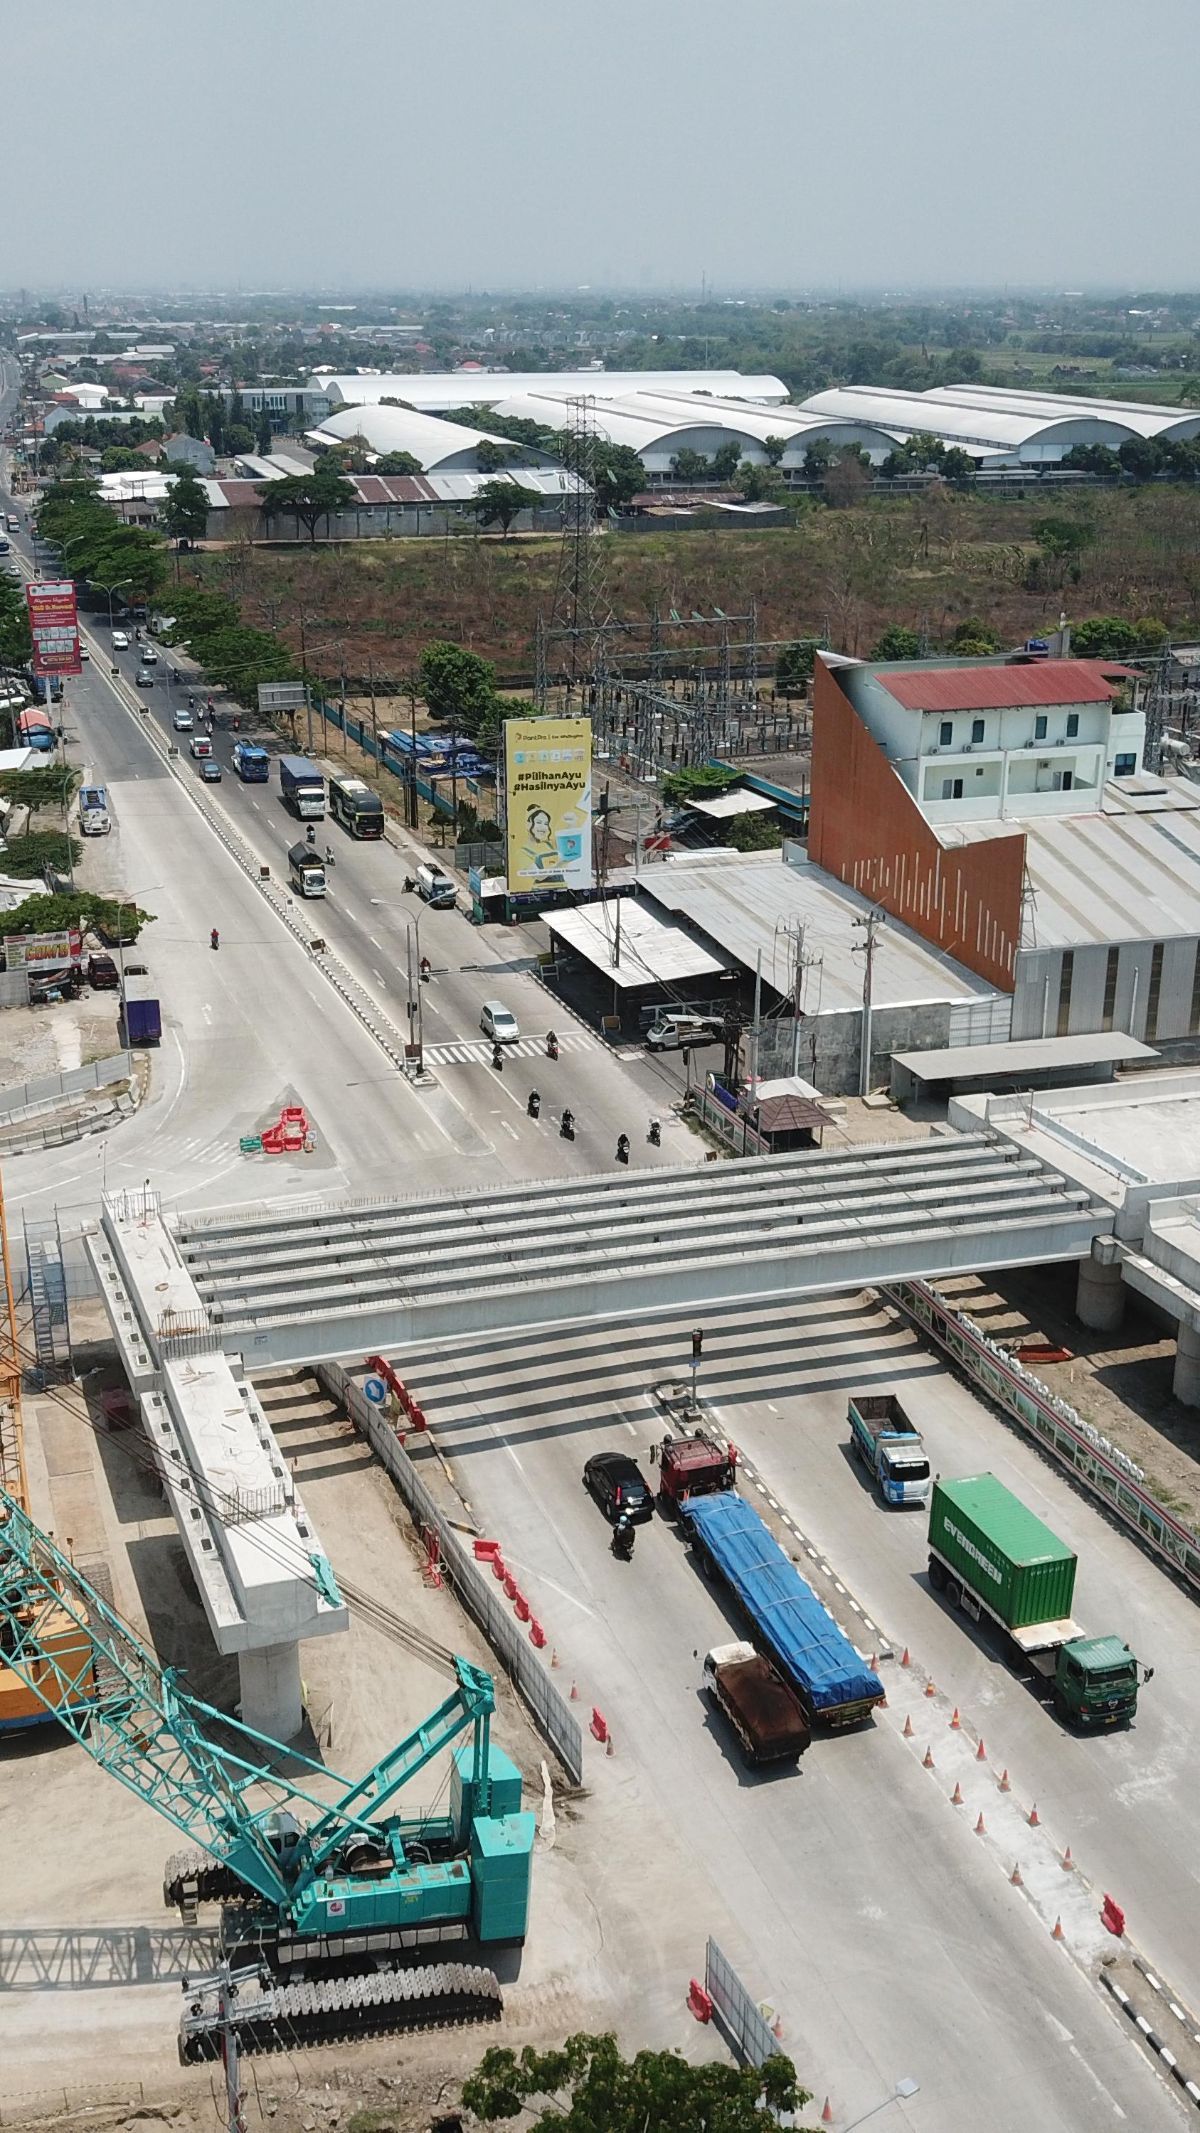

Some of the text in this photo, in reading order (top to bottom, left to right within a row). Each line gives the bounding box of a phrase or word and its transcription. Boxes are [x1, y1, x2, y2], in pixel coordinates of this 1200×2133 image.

[518, 771, 582, 781] #PilihanAyu
[514, 781, 586, 792] #HasilnyaAyu
[943, 1516, 1003, 1585] EVERGREEN
